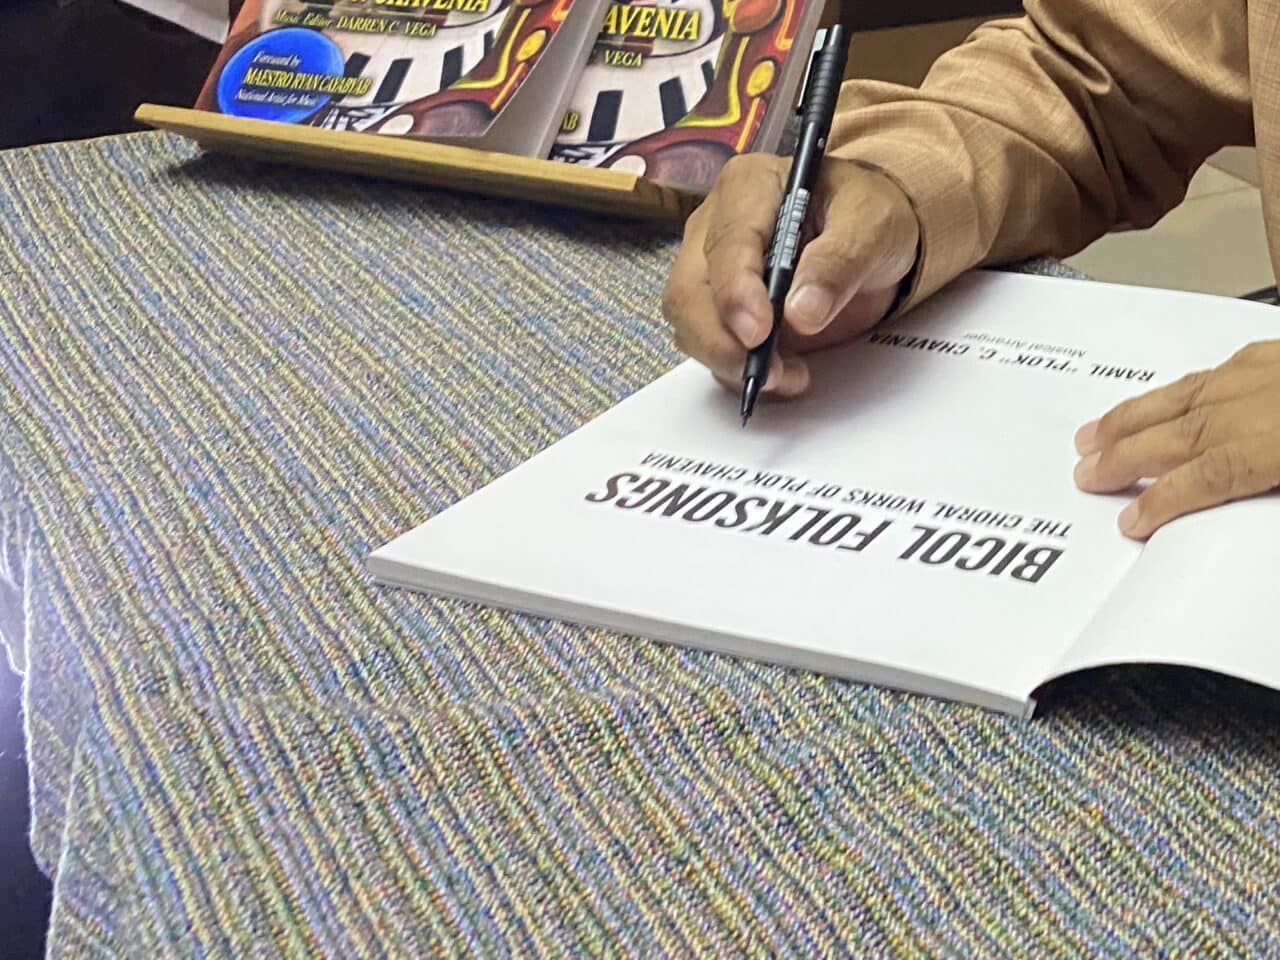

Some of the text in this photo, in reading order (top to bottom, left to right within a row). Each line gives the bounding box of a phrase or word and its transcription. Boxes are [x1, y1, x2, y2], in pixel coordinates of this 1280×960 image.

[336, 15, 387, 33] DARREN
[404, 22, 439, 37] VEGA
[602, 4, 702, 40] AVENIA
[603, 49, 644, 68] VEGA
[245, 68, 291, 88] MAESTRO
[868, 334, 971, 356] CHAVENIA
[1088, 363, 1156, 382] RAMIL
[640, 452, 1074, 537] THE CHORAL WORKS OF PLOK CHAVENIA
[584, 472, 1066, 584] BICOL FOLKSONGS
